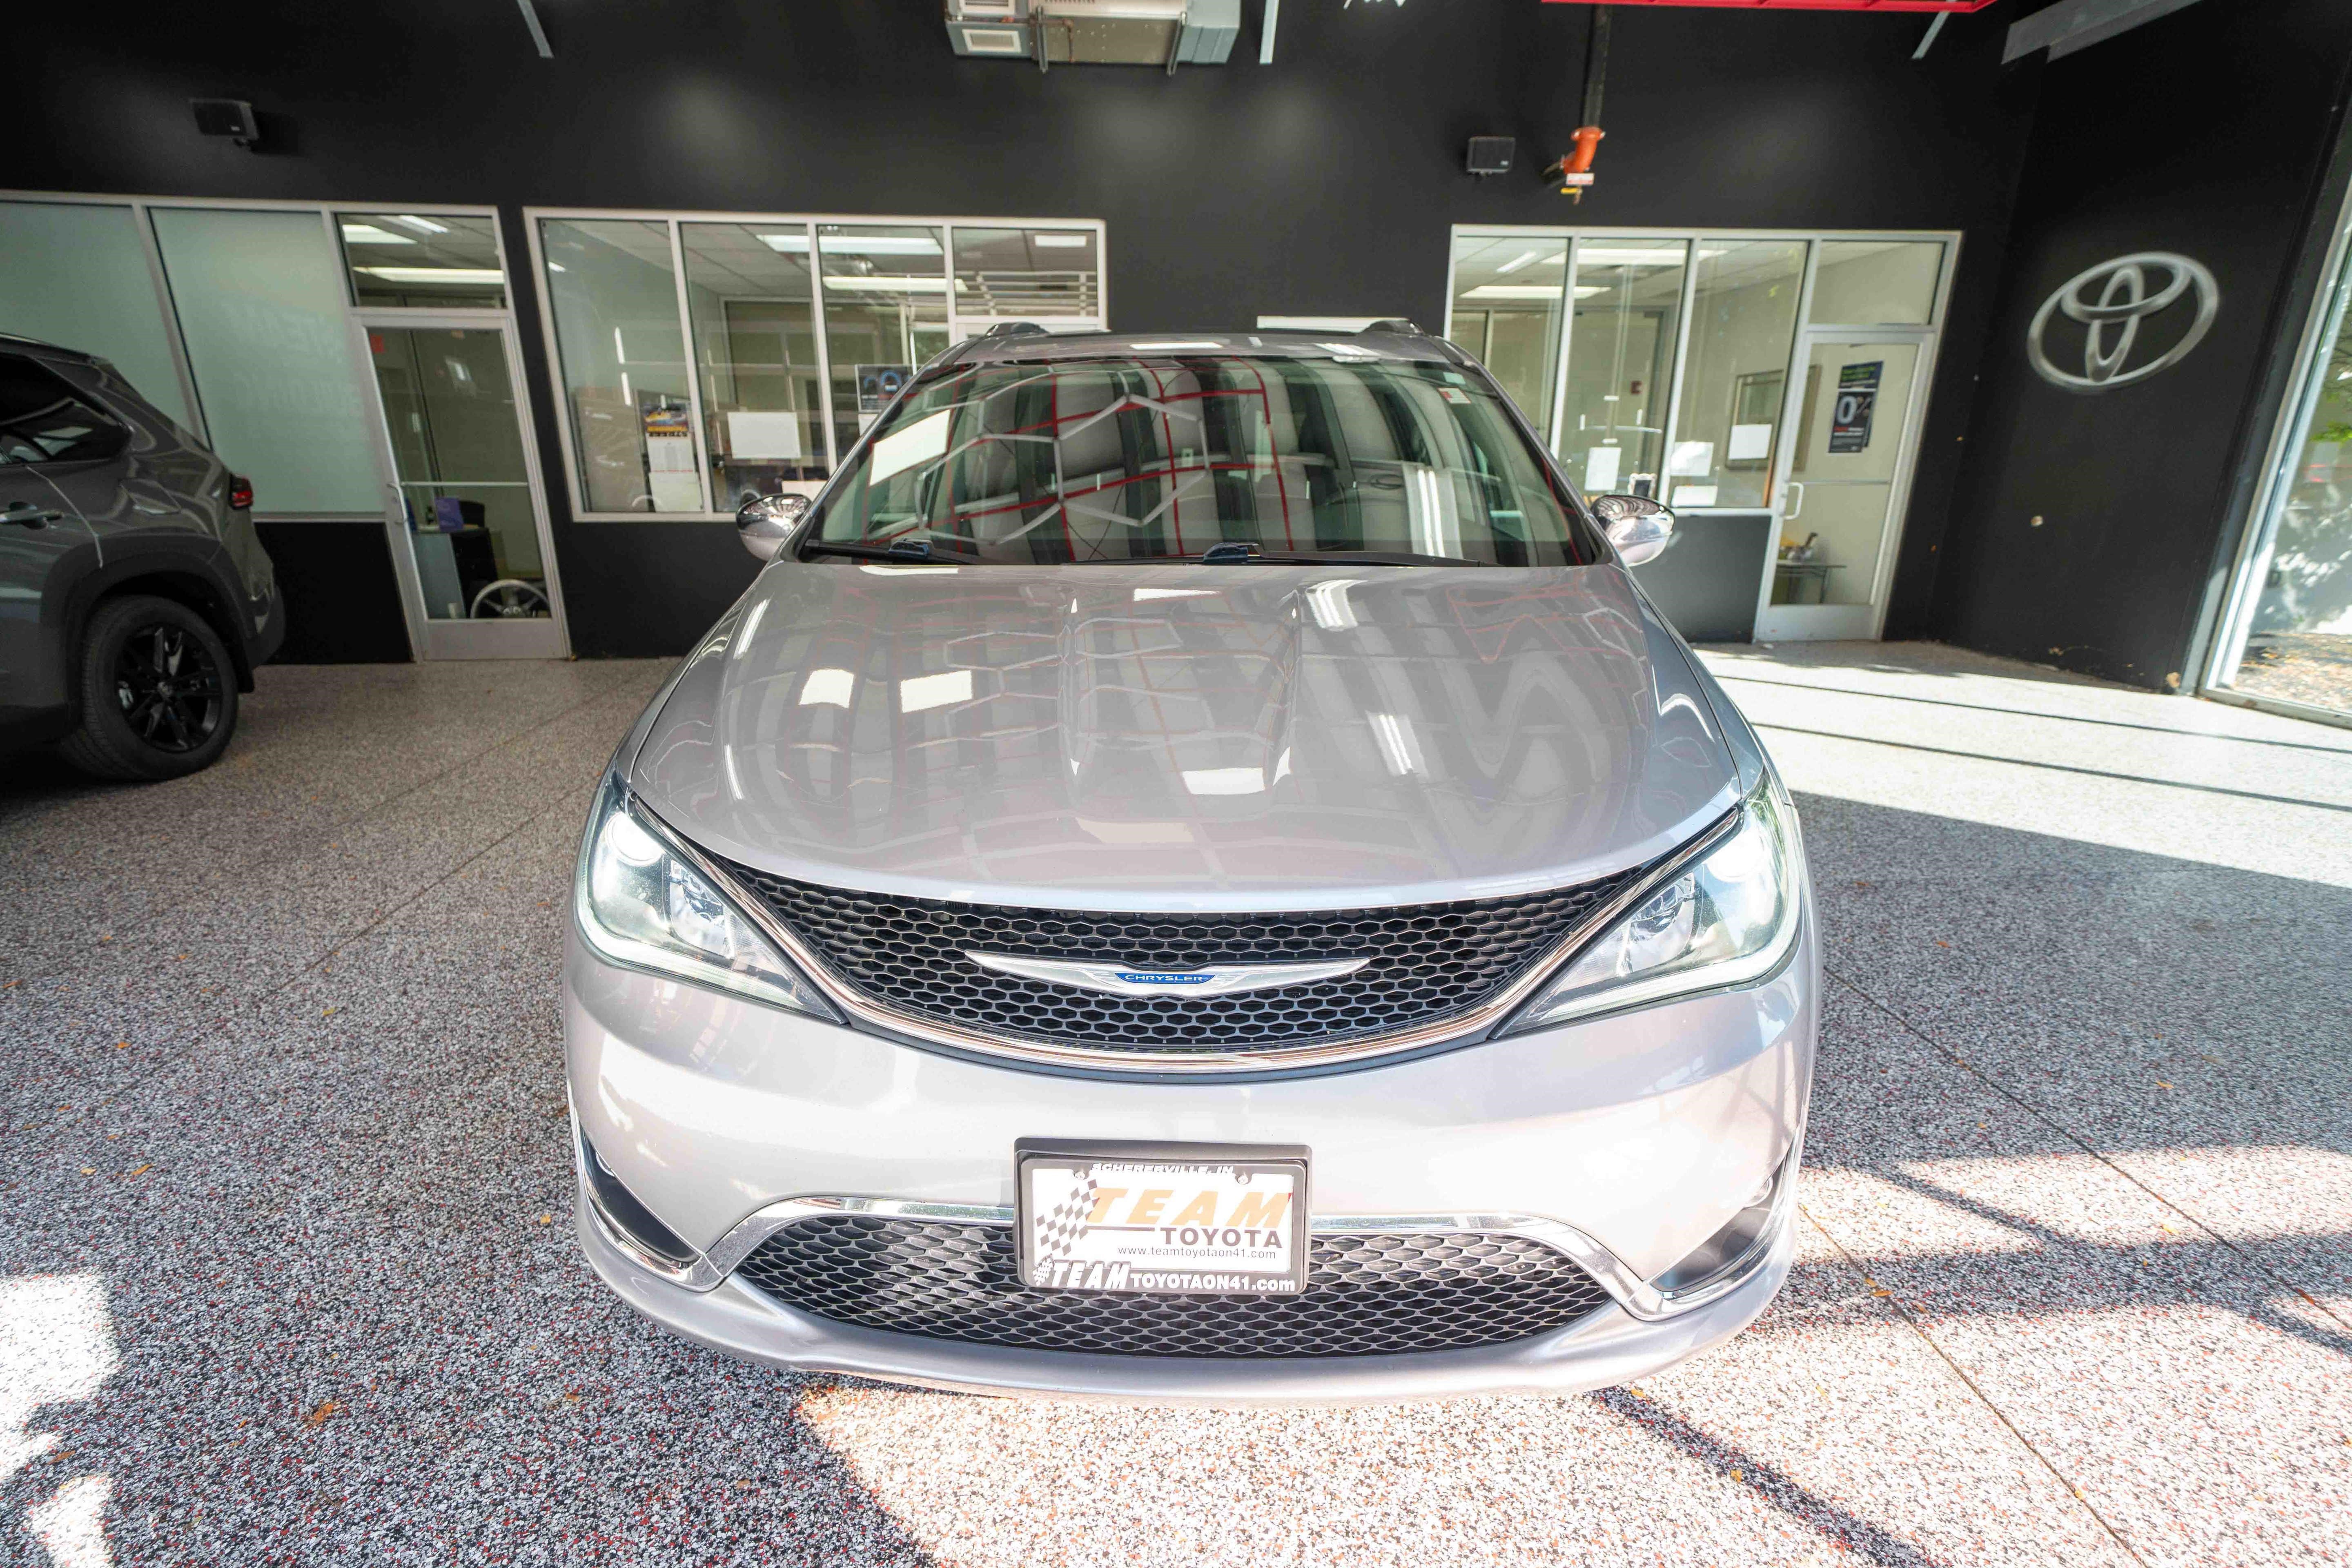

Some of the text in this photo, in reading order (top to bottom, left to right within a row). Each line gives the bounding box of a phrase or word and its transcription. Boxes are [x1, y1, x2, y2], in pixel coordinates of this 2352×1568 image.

[1086, 1187, 1291, 1227] TEAM
[1160, 1228, 1282, 1248] TOYOTA
[1118, 1246, 1276, 1259] www.teamtoyotaon41.com
[1051, 1261, 1295, 1291] TEAM TOYOTAON41.com
